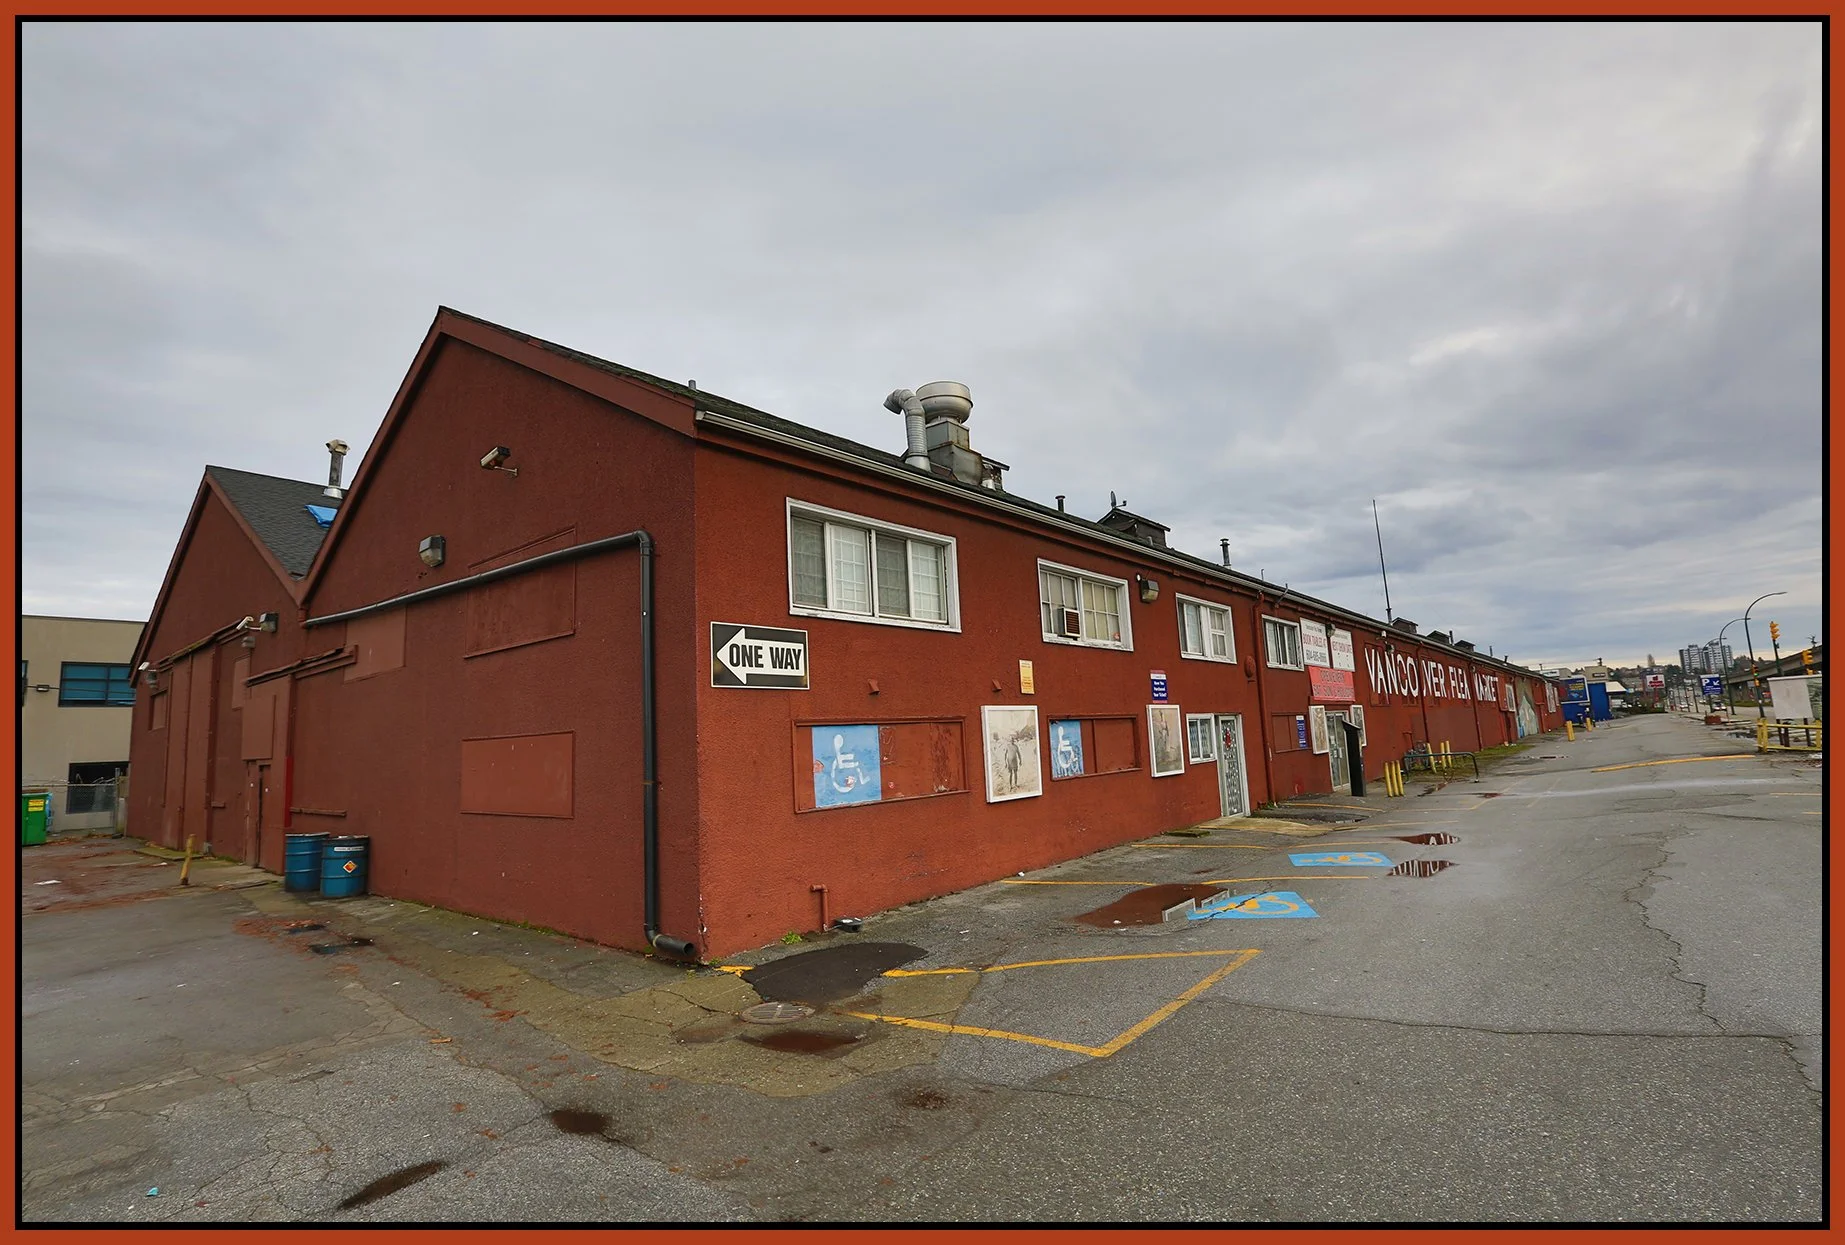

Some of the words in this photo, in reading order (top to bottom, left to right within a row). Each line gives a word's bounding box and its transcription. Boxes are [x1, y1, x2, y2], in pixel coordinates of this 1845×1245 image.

[729, 643, 764, 669] ONE
[769, 646, 802, 670] WAY
[1448, 666, 1471, 700] FLEA
